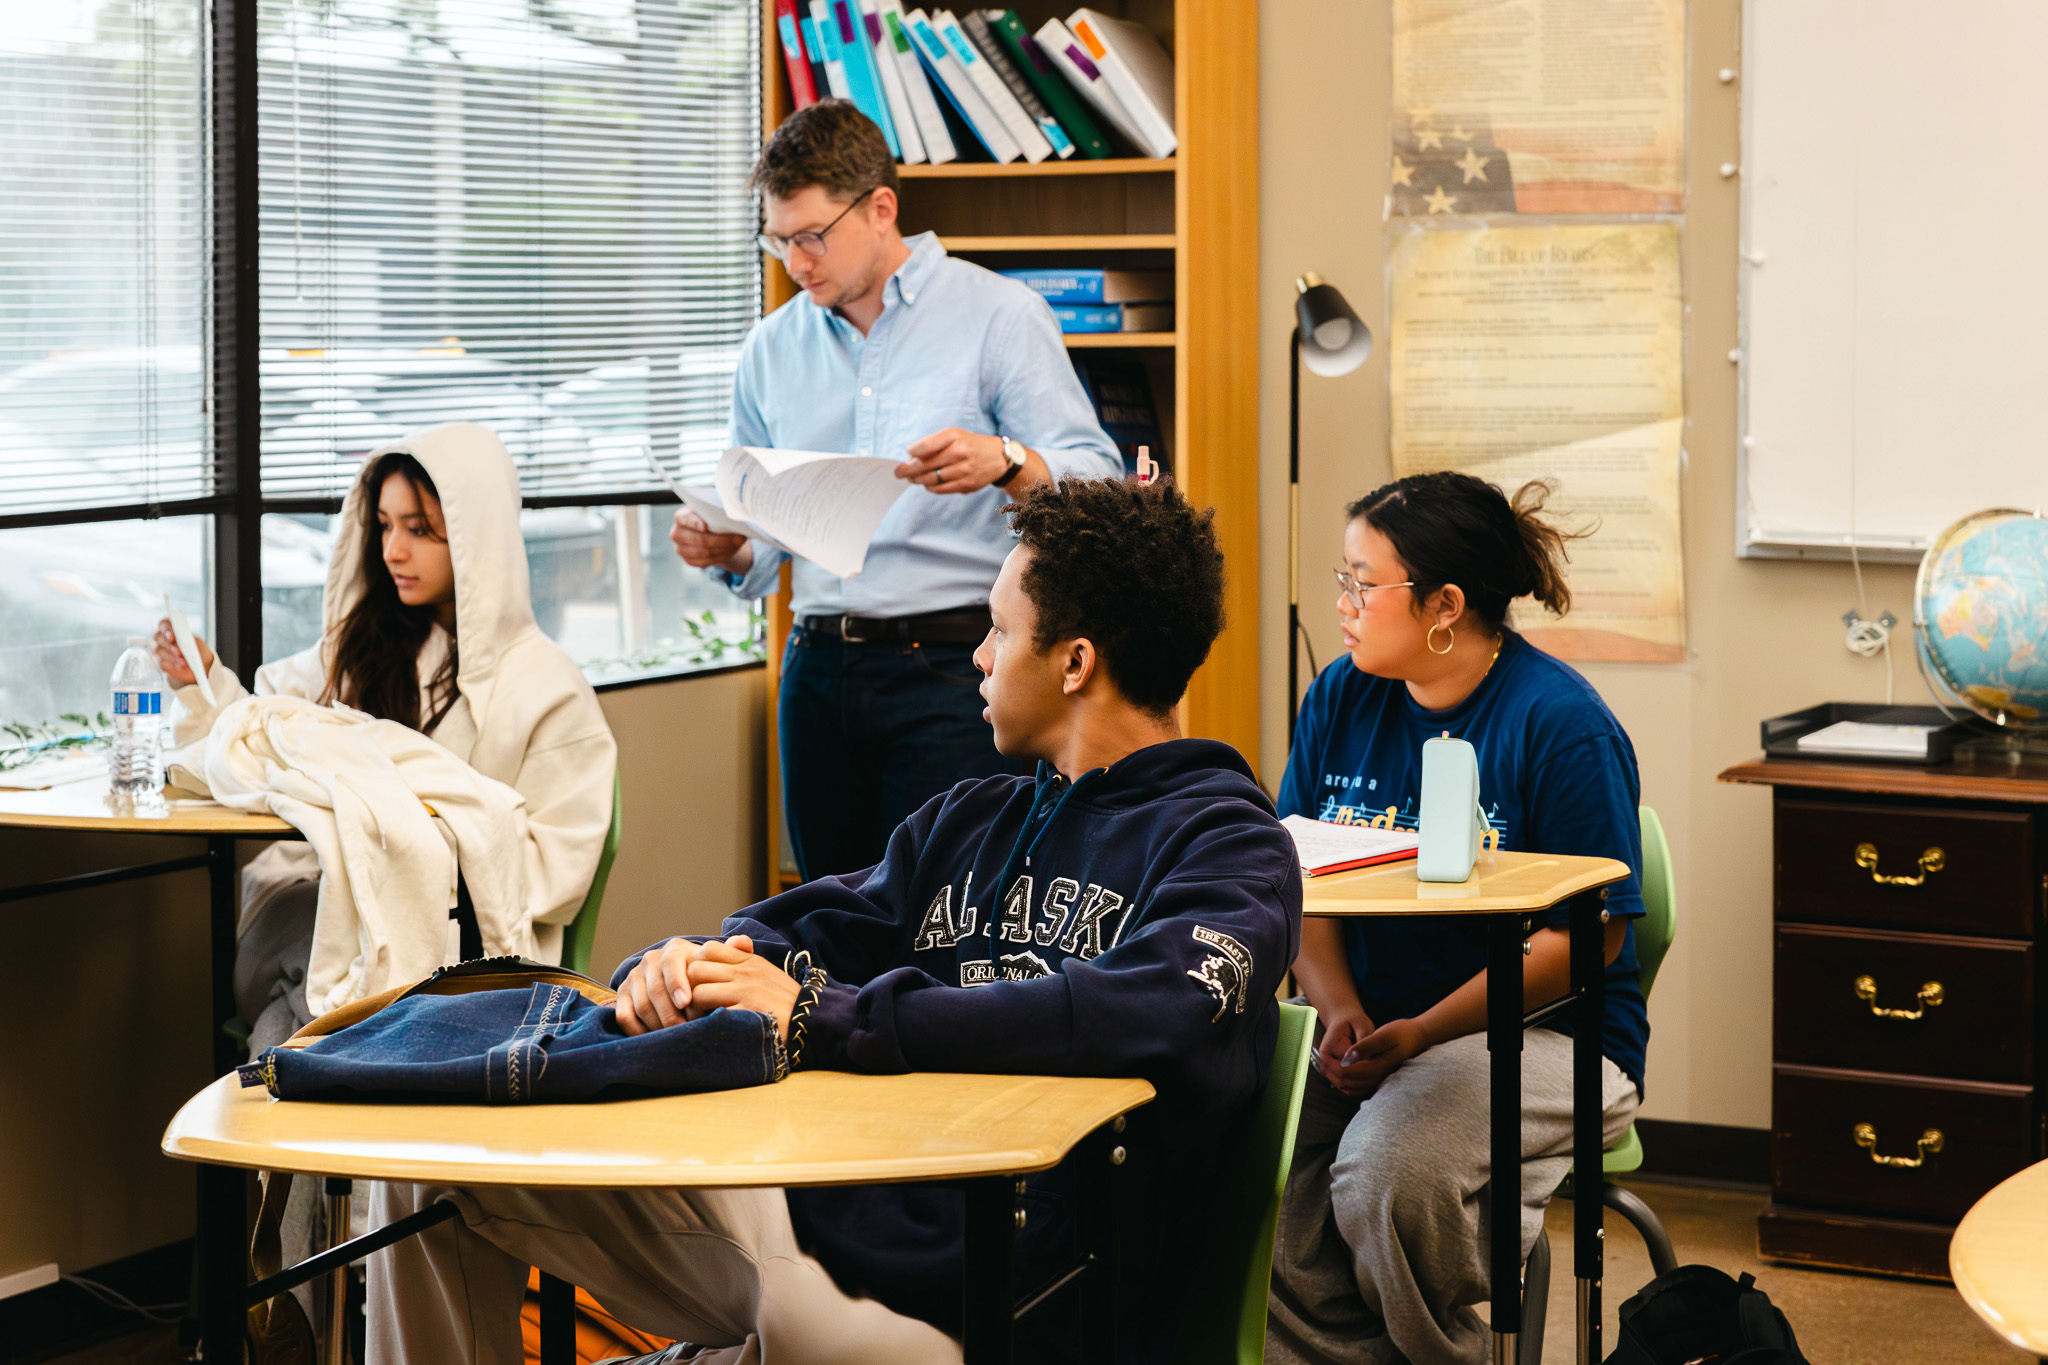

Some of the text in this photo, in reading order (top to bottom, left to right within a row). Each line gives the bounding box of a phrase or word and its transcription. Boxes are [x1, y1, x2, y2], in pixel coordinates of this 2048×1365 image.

[1325, 773, 1349, 789] are
[914, 871, 1134, 961] ALASK
[1200, 929, 1244, 961] THE LAST
